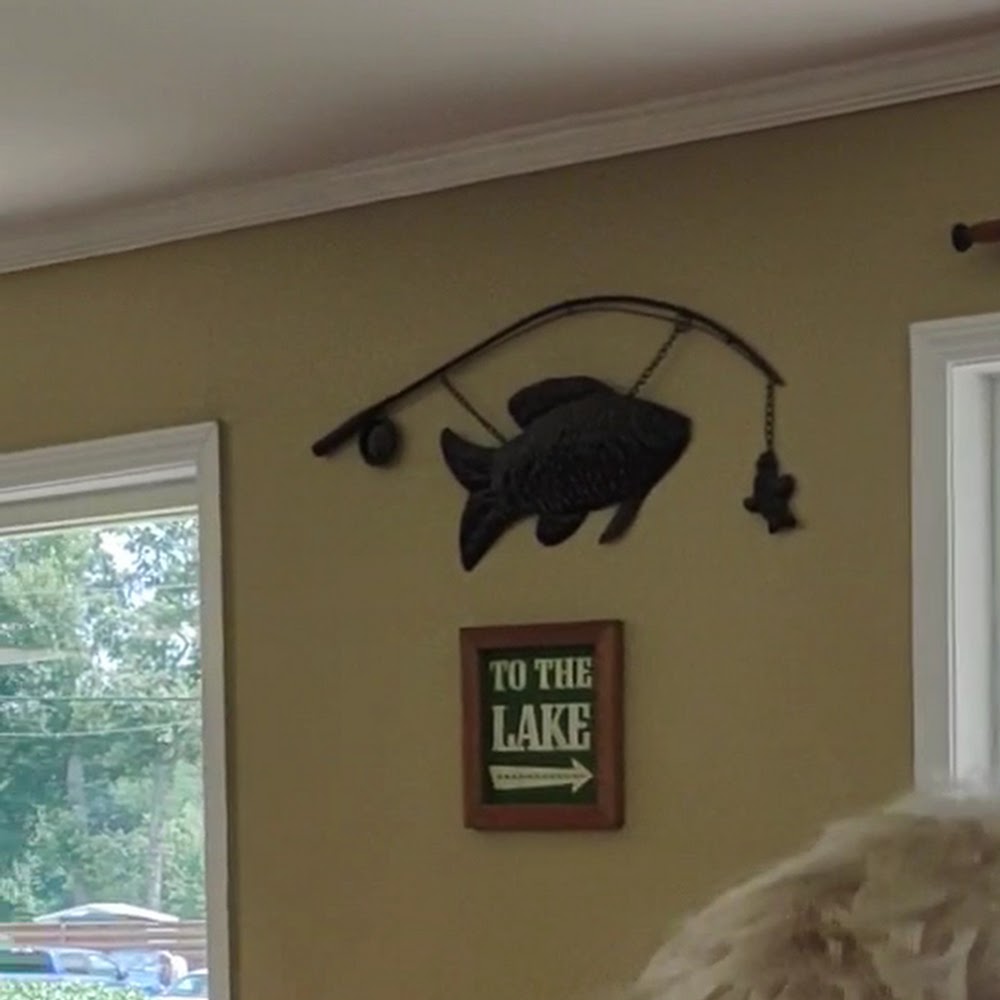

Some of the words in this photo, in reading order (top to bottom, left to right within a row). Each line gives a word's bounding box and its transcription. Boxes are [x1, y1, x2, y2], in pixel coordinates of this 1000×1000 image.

[489, 659, 527, 691] TO
[534, 656, 593, 690] THE
[491, 702, 591, 752] LAKE
